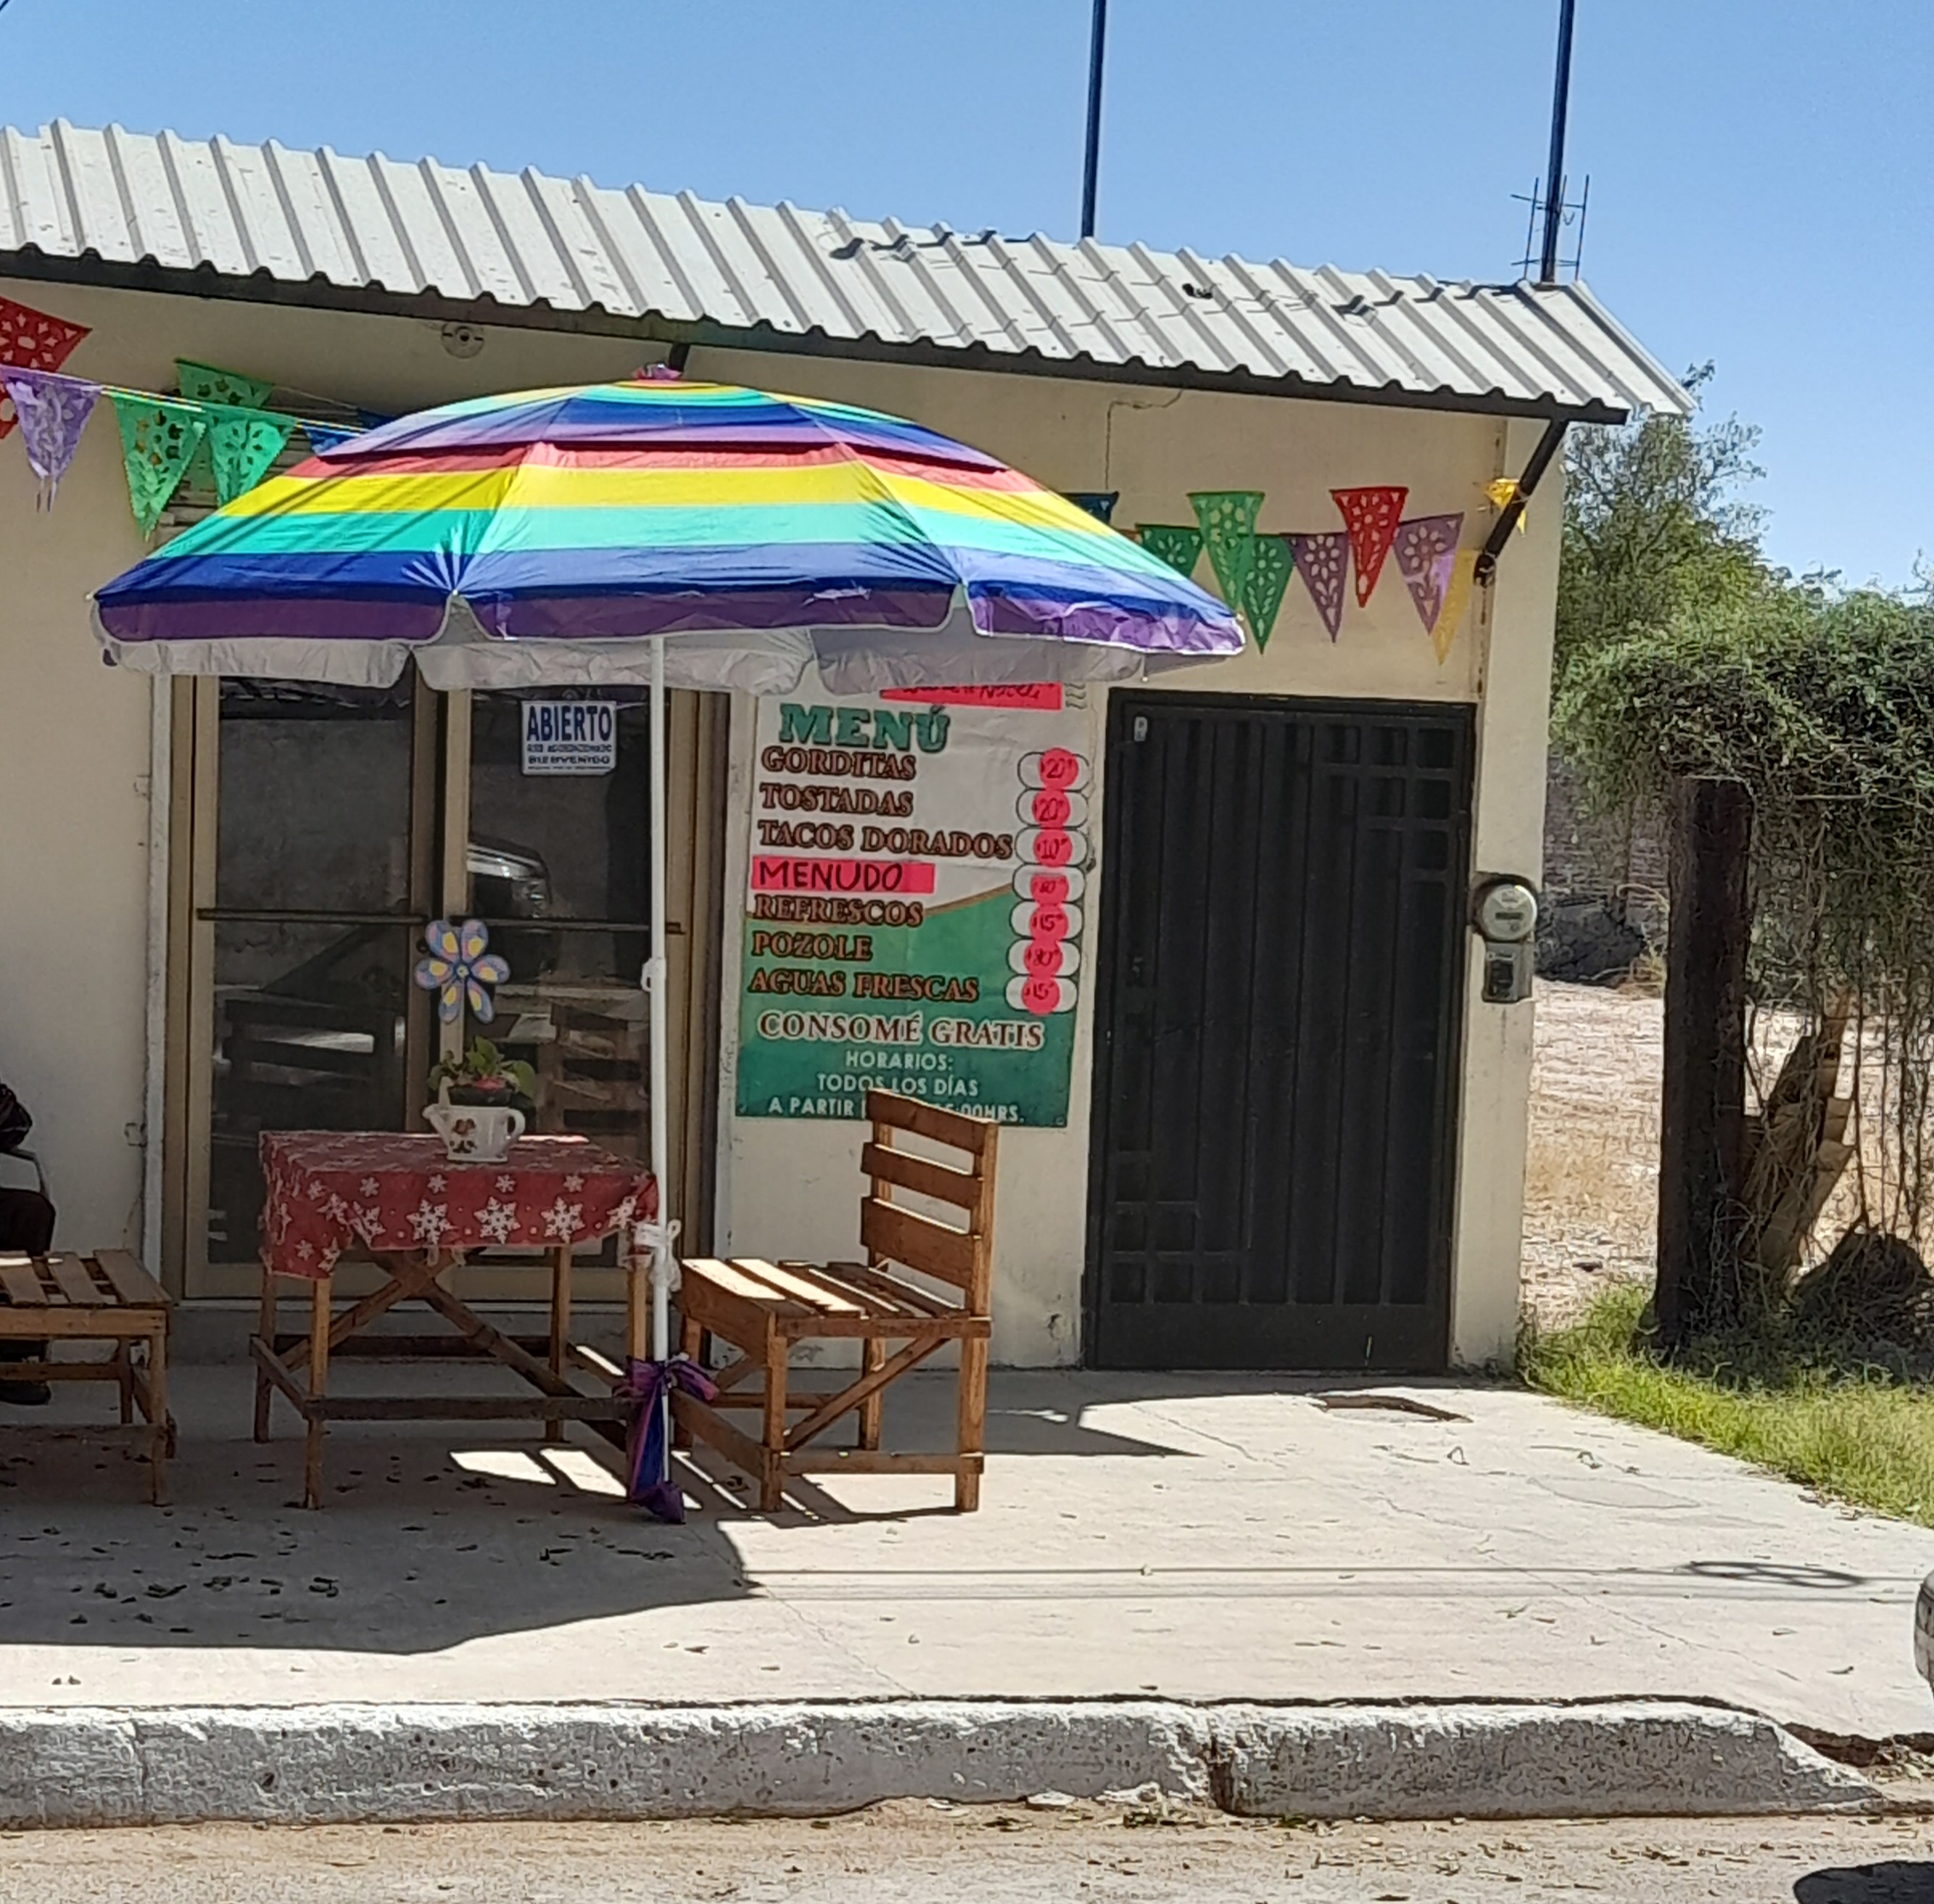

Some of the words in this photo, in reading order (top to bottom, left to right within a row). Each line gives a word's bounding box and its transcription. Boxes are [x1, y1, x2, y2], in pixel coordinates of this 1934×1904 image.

[526, 705, 612, 741] ABIERTO
[779, 703, 950, 753] MENÚ
[761, 745, 917, 780] GORDITAS
[759, 782, 914, 817] TOSTADAS
[758, 820, 854, 850] TACOS
[861, 827, 1013, 860] DORADOS
[759, 861, 903, 891] MENUDO
[753, 894, 923, 927] REFRESCOS
[751, 930, 873, 961] POZOLE
[748, 968, 846, 996] AGUAS
[853, 973, 980, 1002] FRESCAS
[758, 1010, 922, 1045] CONSOMÉ
[929, 1017, 1044, 1051] GRATIS
[846, 1051, 954, 1071] HORARIOS:
[818, 1073, 885, 1091] TODOS
[891, 1077, 927, 1095] LOS
[934, 1074, 978, 1096] DÍAS
[769, 1097, 783, 1114] A
[790, 1097, 854, 1117] PARTIR
